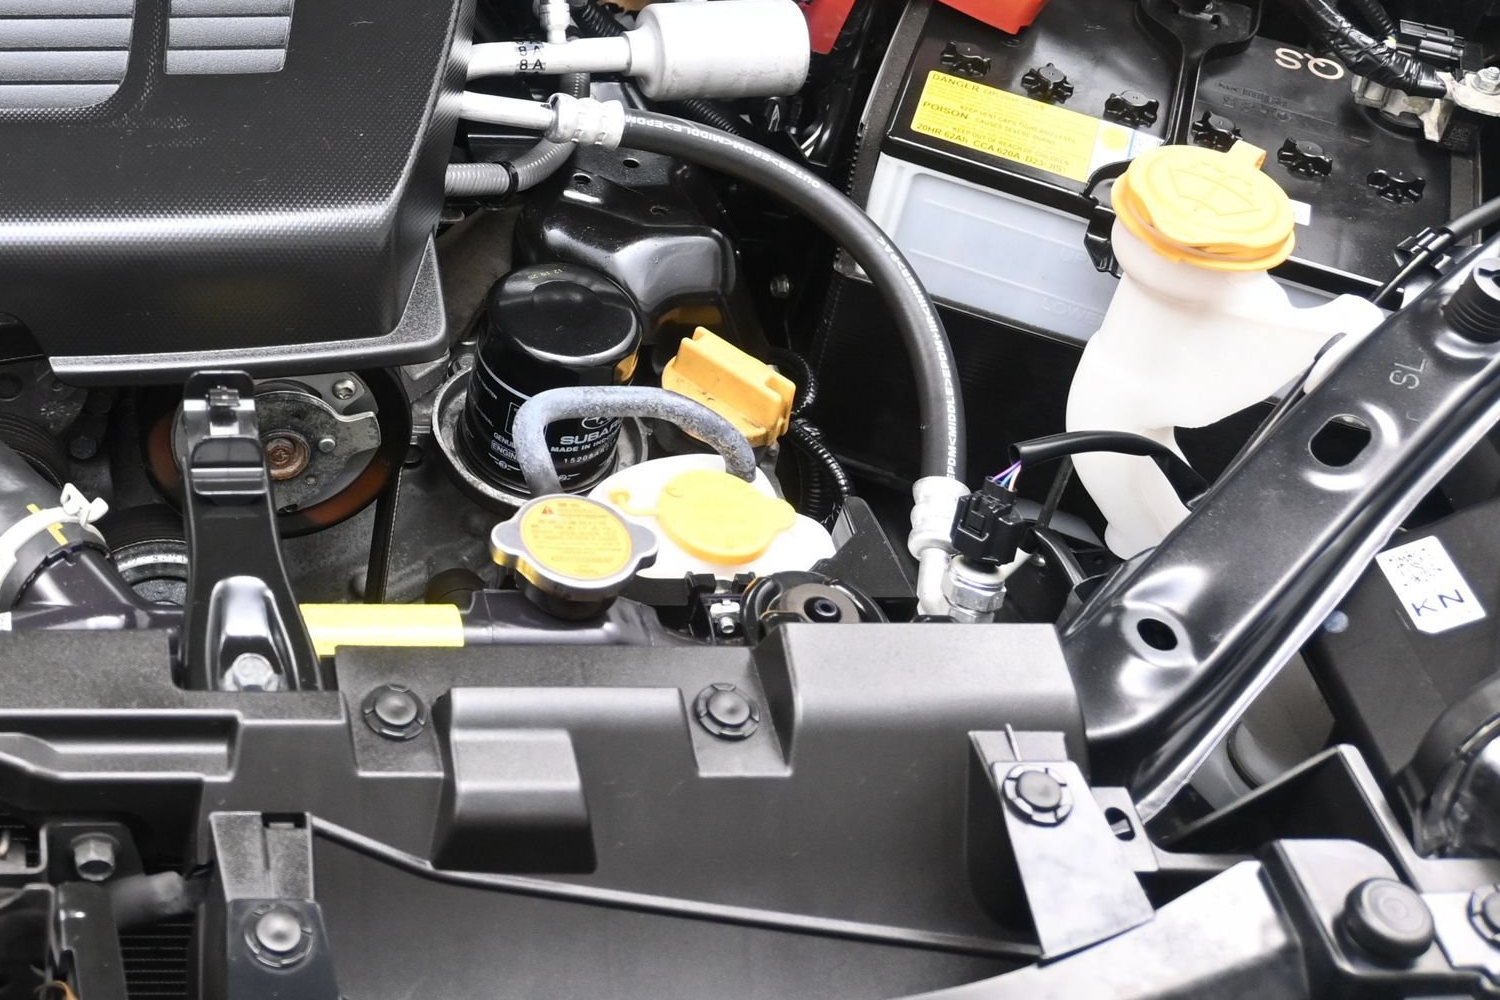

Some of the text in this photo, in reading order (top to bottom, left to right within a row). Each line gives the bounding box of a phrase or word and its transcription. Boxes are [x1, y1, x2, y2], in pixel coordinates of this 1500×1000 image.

[932, 73, 978, 92] DANGER
[923, 101, 968, 120] POISON
[917, 122, 941, 135] 20HR
[944, 130, 967, 143] 62Ah
[973, 139, 994, 151] CCA
[996, 146, 1019, 159] 620A
[492, 441, 518, 461] ENGIN
